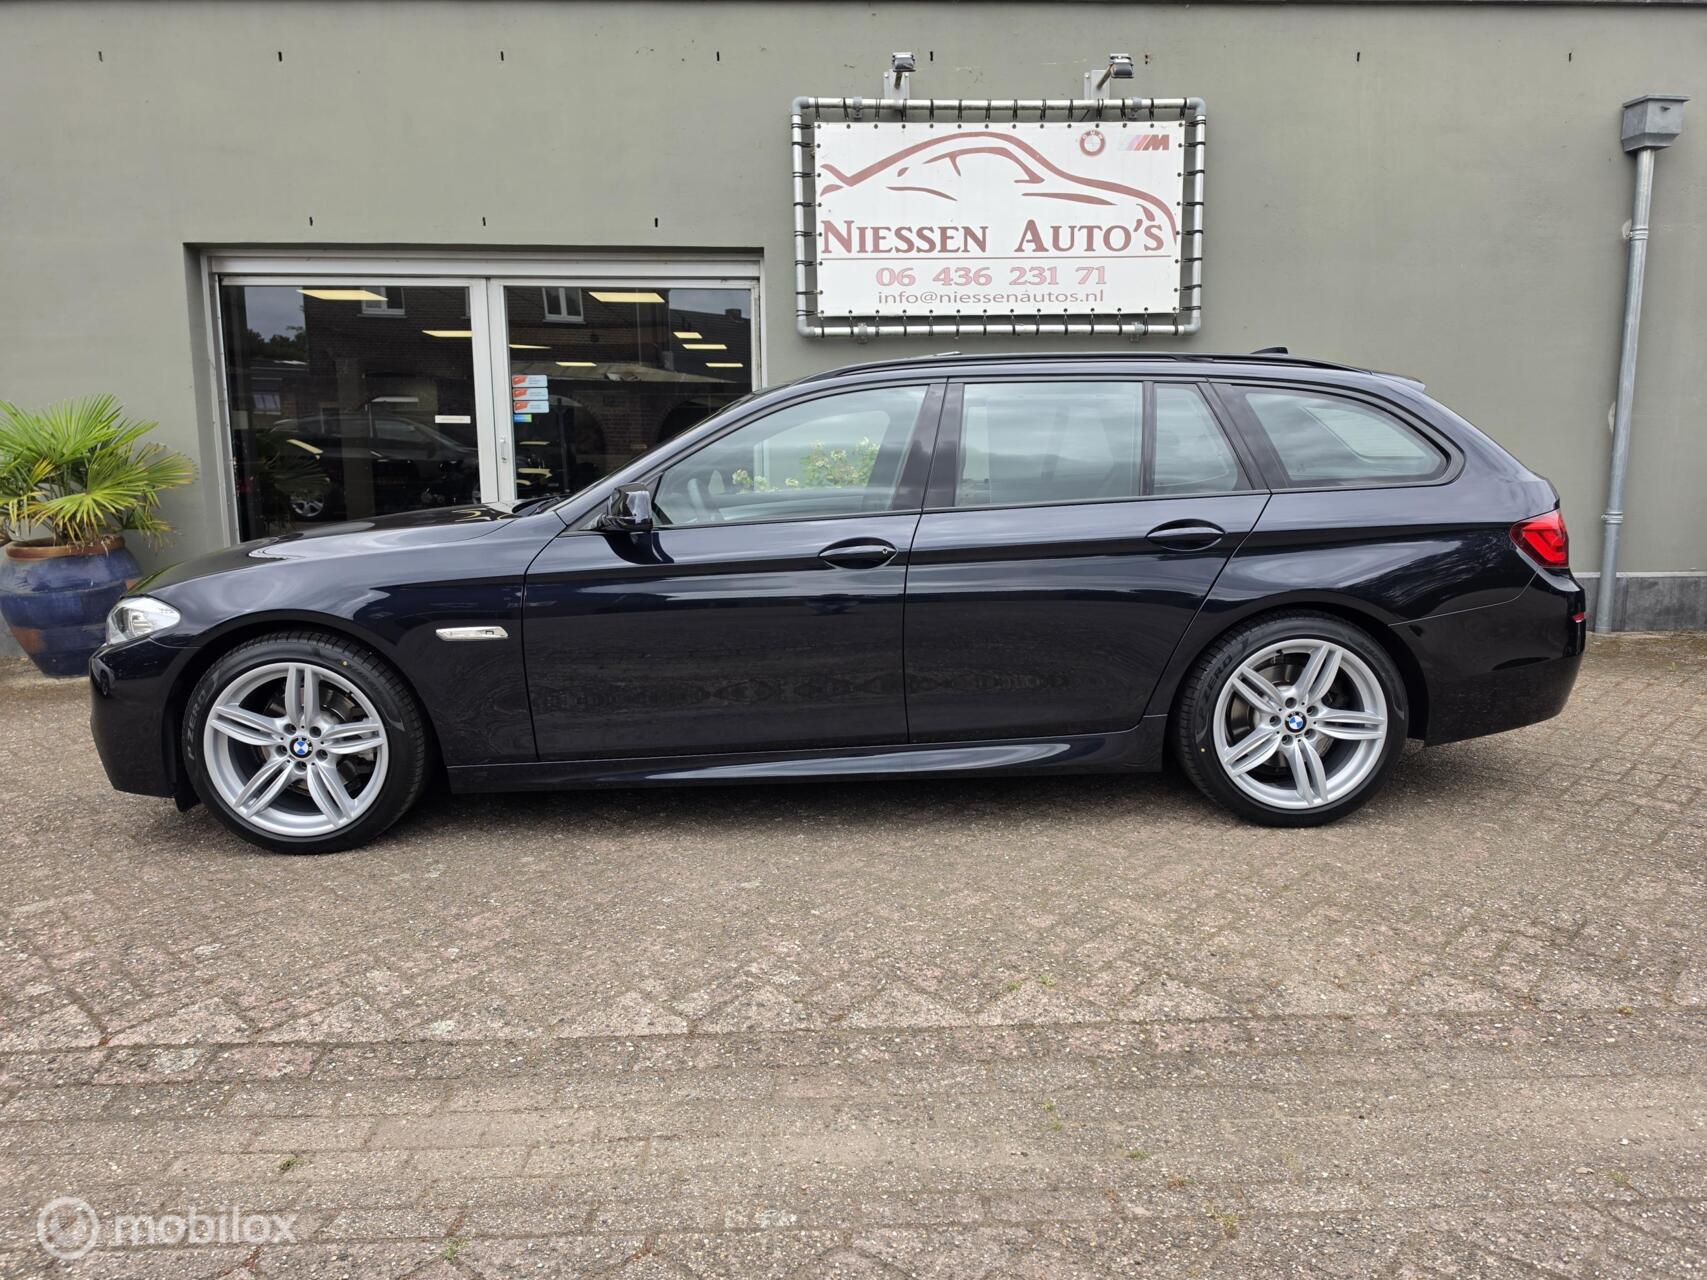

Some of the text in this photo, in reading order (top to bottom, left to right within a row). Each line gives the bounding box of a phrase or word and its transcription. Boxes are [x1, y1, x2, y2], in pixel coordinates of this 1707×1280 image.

[875, 265, 1107, 288] 06 436 231 71
[878, 289, 1105, 305] info@niessenautos.nl
